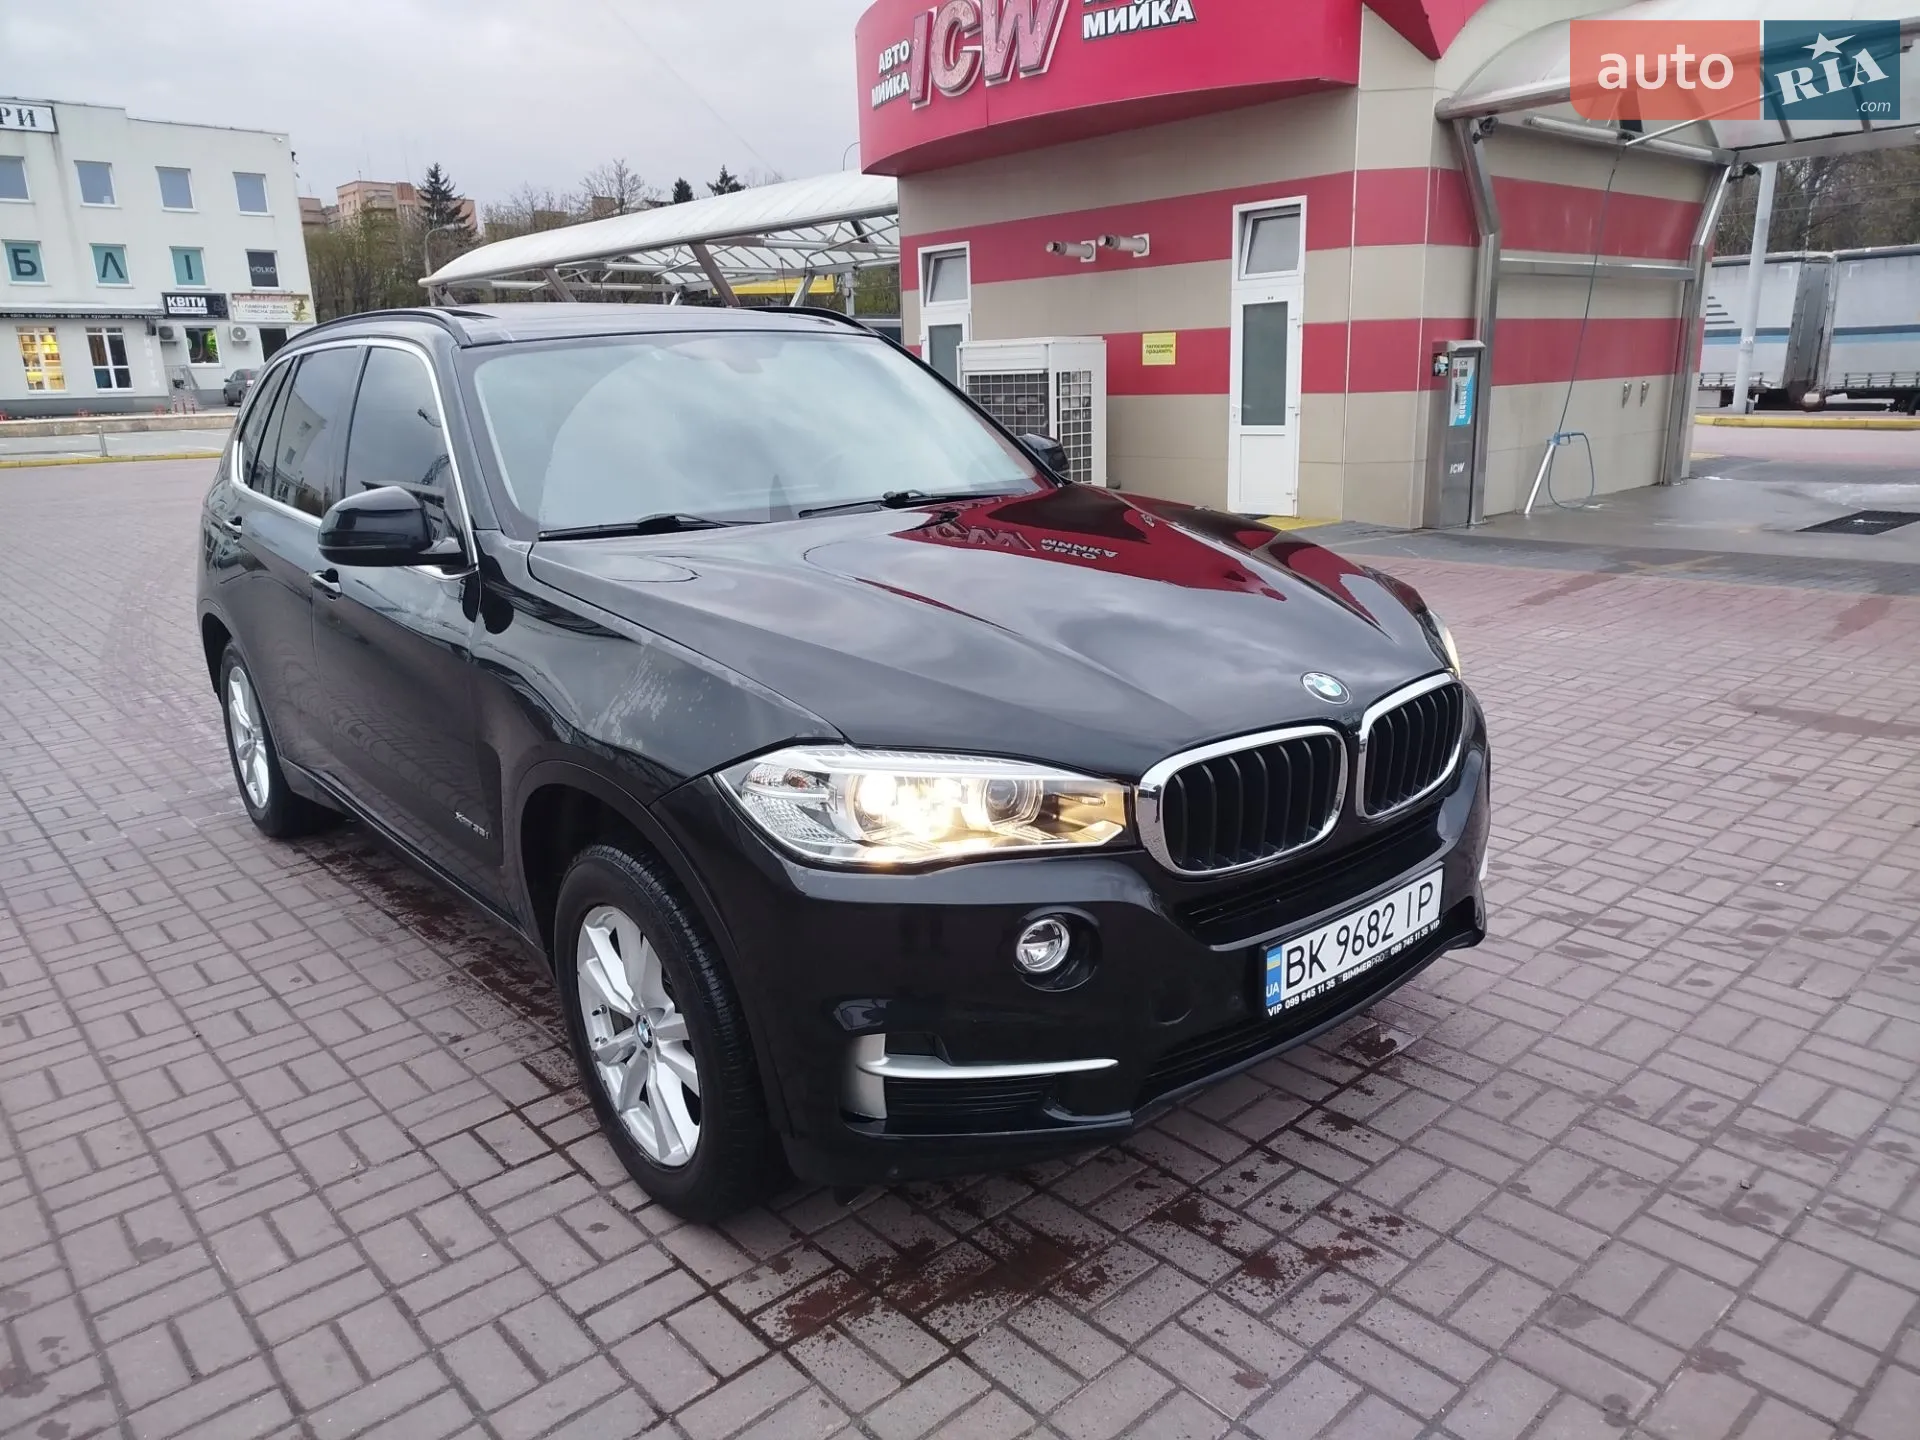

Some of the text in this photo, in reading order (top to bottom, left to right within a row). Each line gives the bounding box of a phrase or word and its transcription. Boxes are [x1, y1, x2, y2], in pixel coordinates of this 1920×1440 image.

[1083, 0, 1195, 40] МИЙКА
[878, 40, 910, 75] АВТО
[909, 0, 1068, 110] ICW
[871, 71, 910, 108] МИЙКА
[166, 296, 207, 307] КВІТИ
[1449, 462, 1465, 474] ICW
[1286, 881, 1433, 990] BK 9682 IP
[1268, 1004, 1283, 1017] VIP
[1285, 996, 1300, 1009] 099
[1318, 984, 1325, 994] 11
[1326, 978, 1336, 990] 35
[1390, 943, 1402, 955] 099
[1414, 931, 1421, 941] 11
[1421, 926, 1429, 937] 35
[1430, 919, 1440, 931] VIP
[1266, 982, 1280, 998] UA
